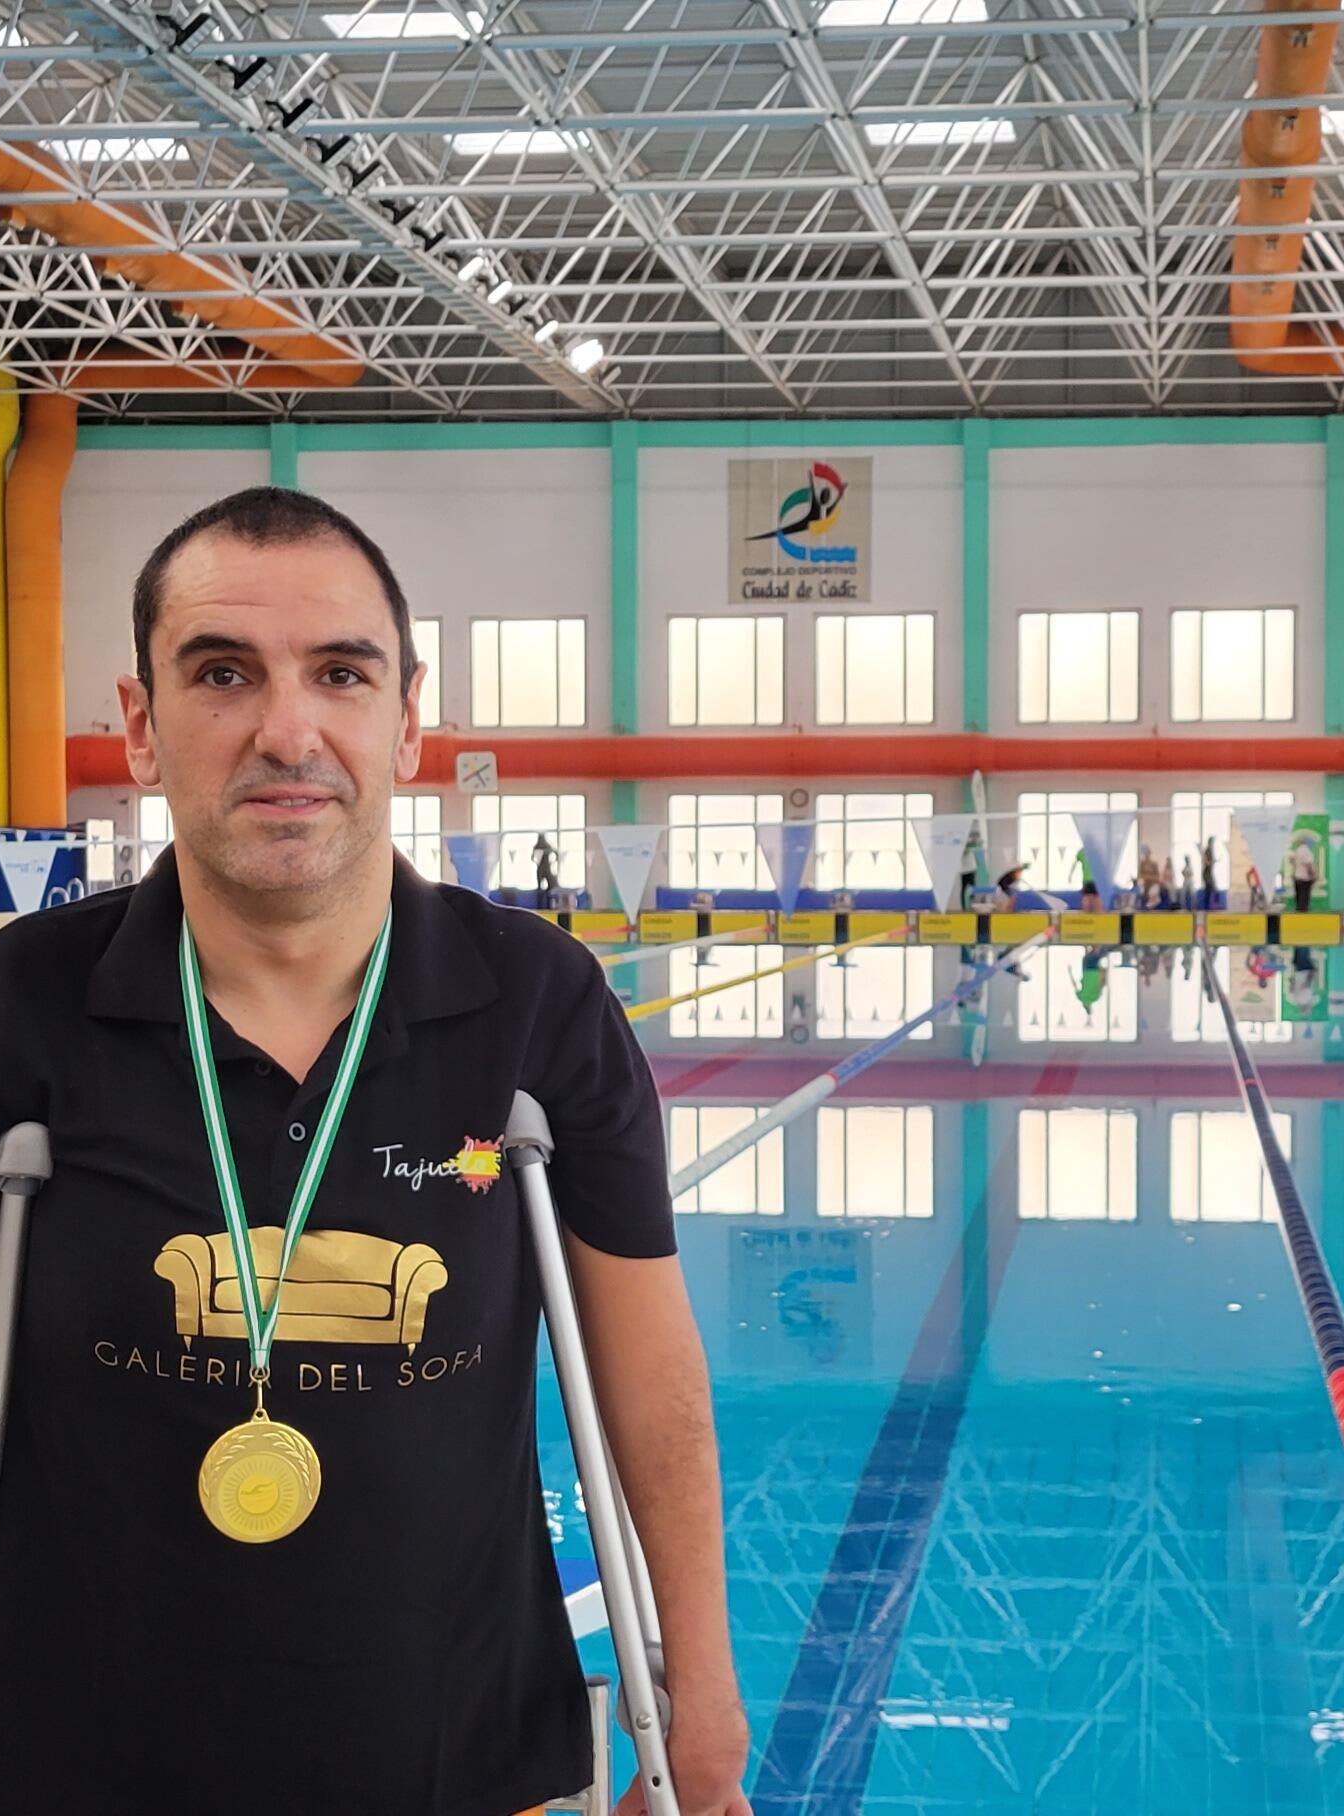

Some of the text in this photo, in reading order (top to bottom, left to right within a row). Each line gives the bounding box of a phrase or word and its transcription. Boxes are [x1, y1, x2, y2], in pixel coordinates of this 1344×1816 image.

[742, 566, 857, 576] COMPLEJO DEPORTIVO
[742, 580, 790, 599] Ciudad
[796, 580, 812, 598] de
[94, 1341, 483, 1392] GALERIA DEL SOFA
